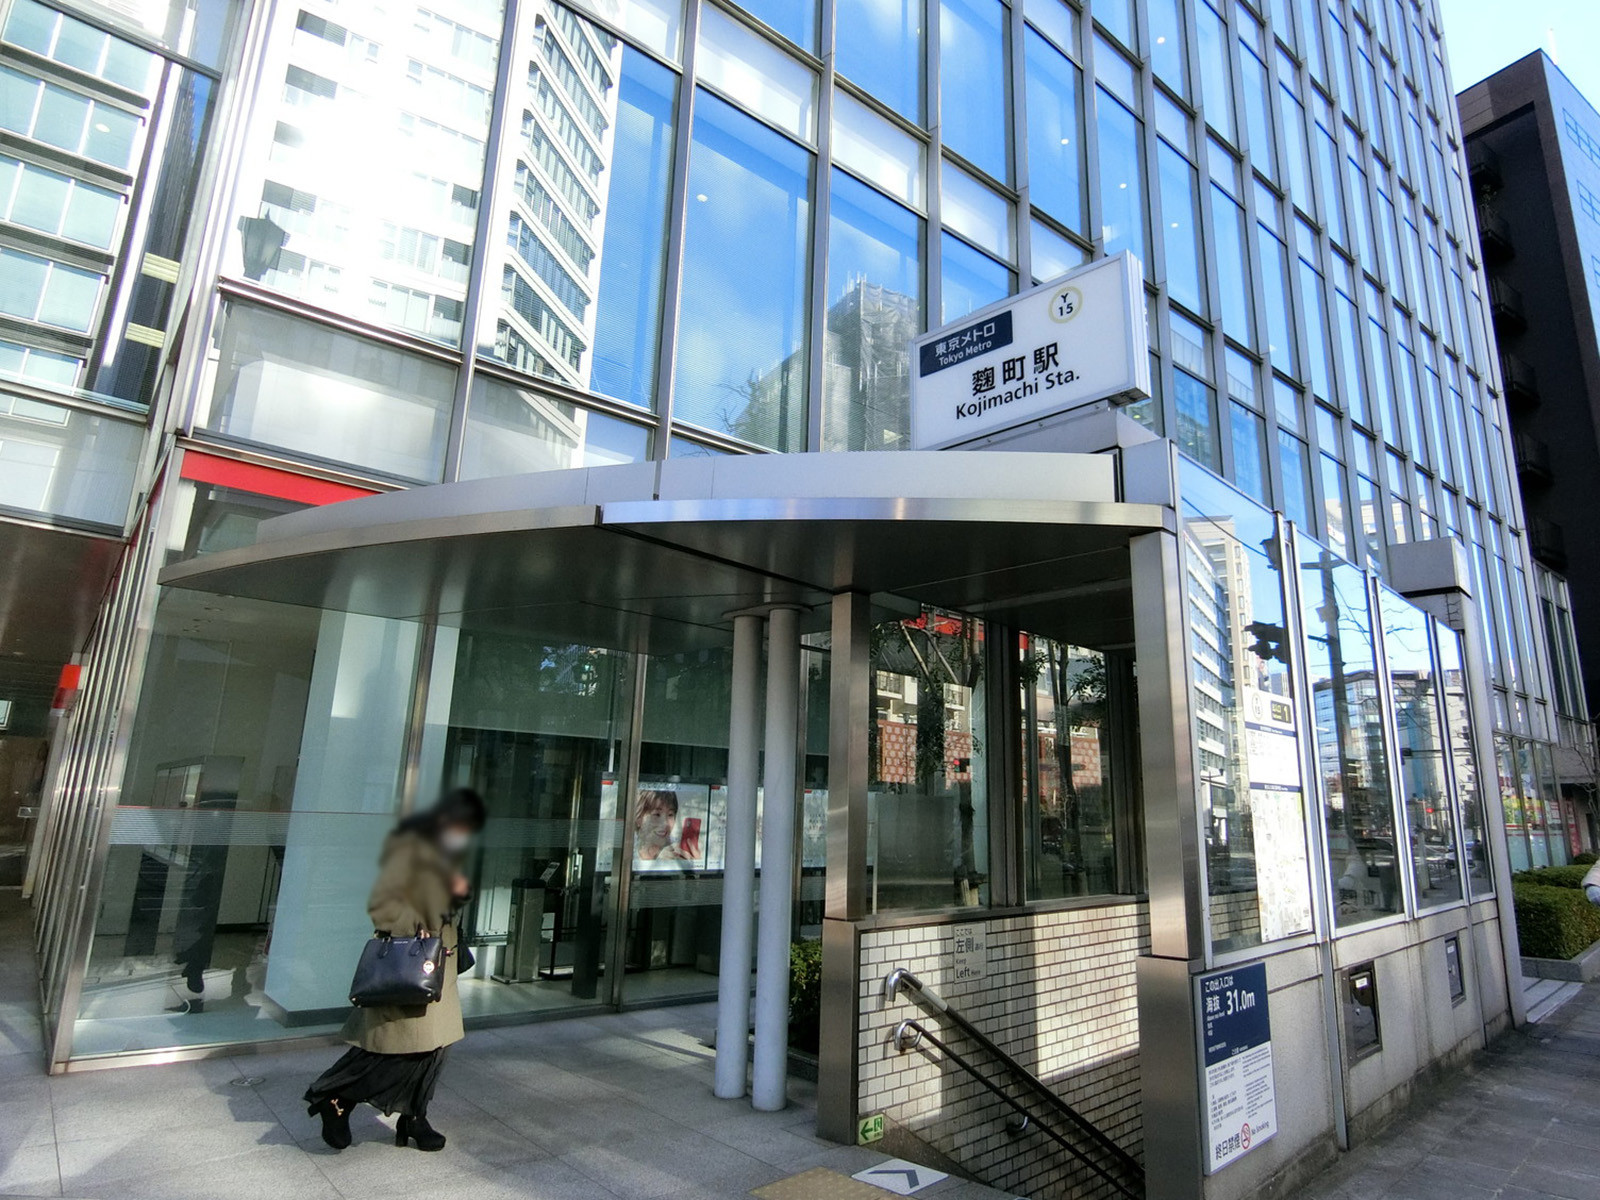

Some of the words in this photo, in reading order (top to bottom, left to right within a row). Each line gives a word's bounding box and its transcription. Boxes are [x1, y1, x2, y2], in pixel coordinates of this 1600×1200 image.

[1061, 293, 1069, 304] Y
[1058, 303, 1074, 317] 15
[935, 322, 996, 357] 東京メトロ
[938, 349, 964, 367] Tokyo
[965, 339, 992, 357] Metro
[956, 377, 1039, 420] Kojimachi
[1045, 366, 1080, 390] Sta.
[956, 936, 974, 954] 左側
[956, 966, 970, 979] Left
[1206, 995, 1221, 1013] 海抜
[1226, 989, 1256, 1016] 31.0m
